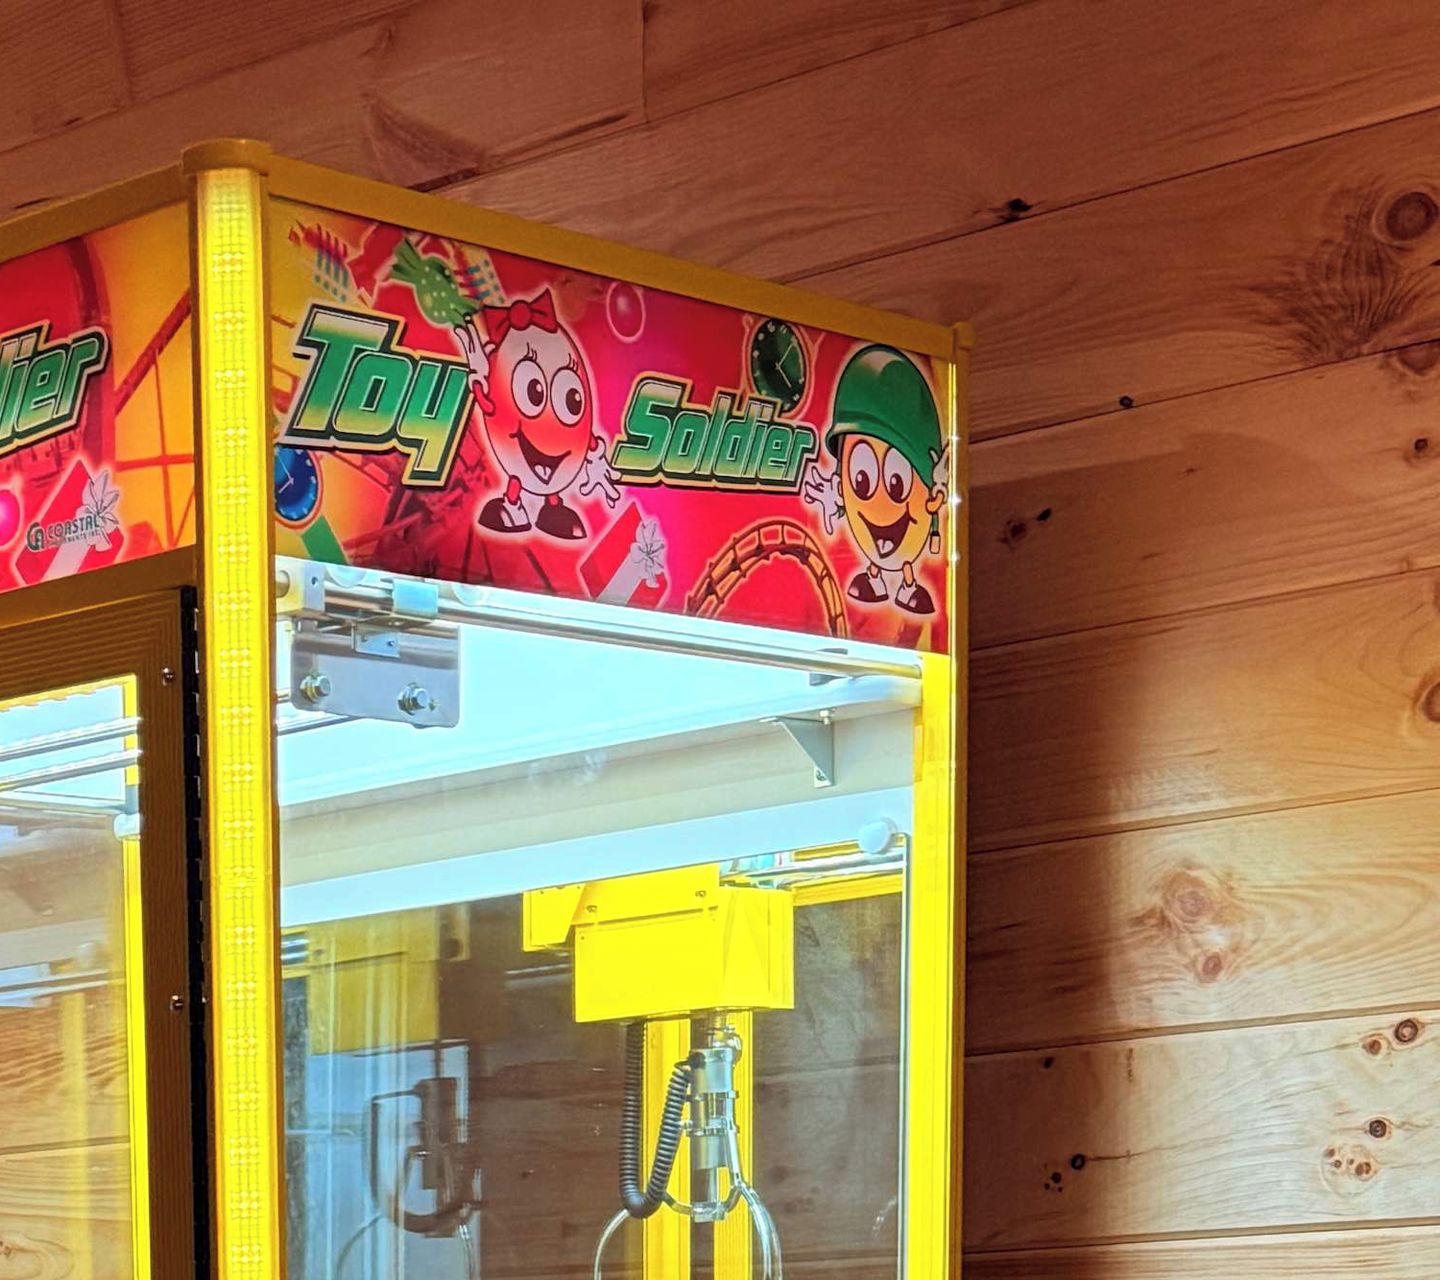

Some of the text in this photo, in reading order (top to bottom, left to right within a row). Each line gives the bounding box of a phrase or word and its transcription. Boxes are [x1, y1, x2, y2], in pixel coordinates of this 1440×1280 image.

[275, 303, 820, 492] Toy Soldier
[47, 515, 100, 539] COASTAL
